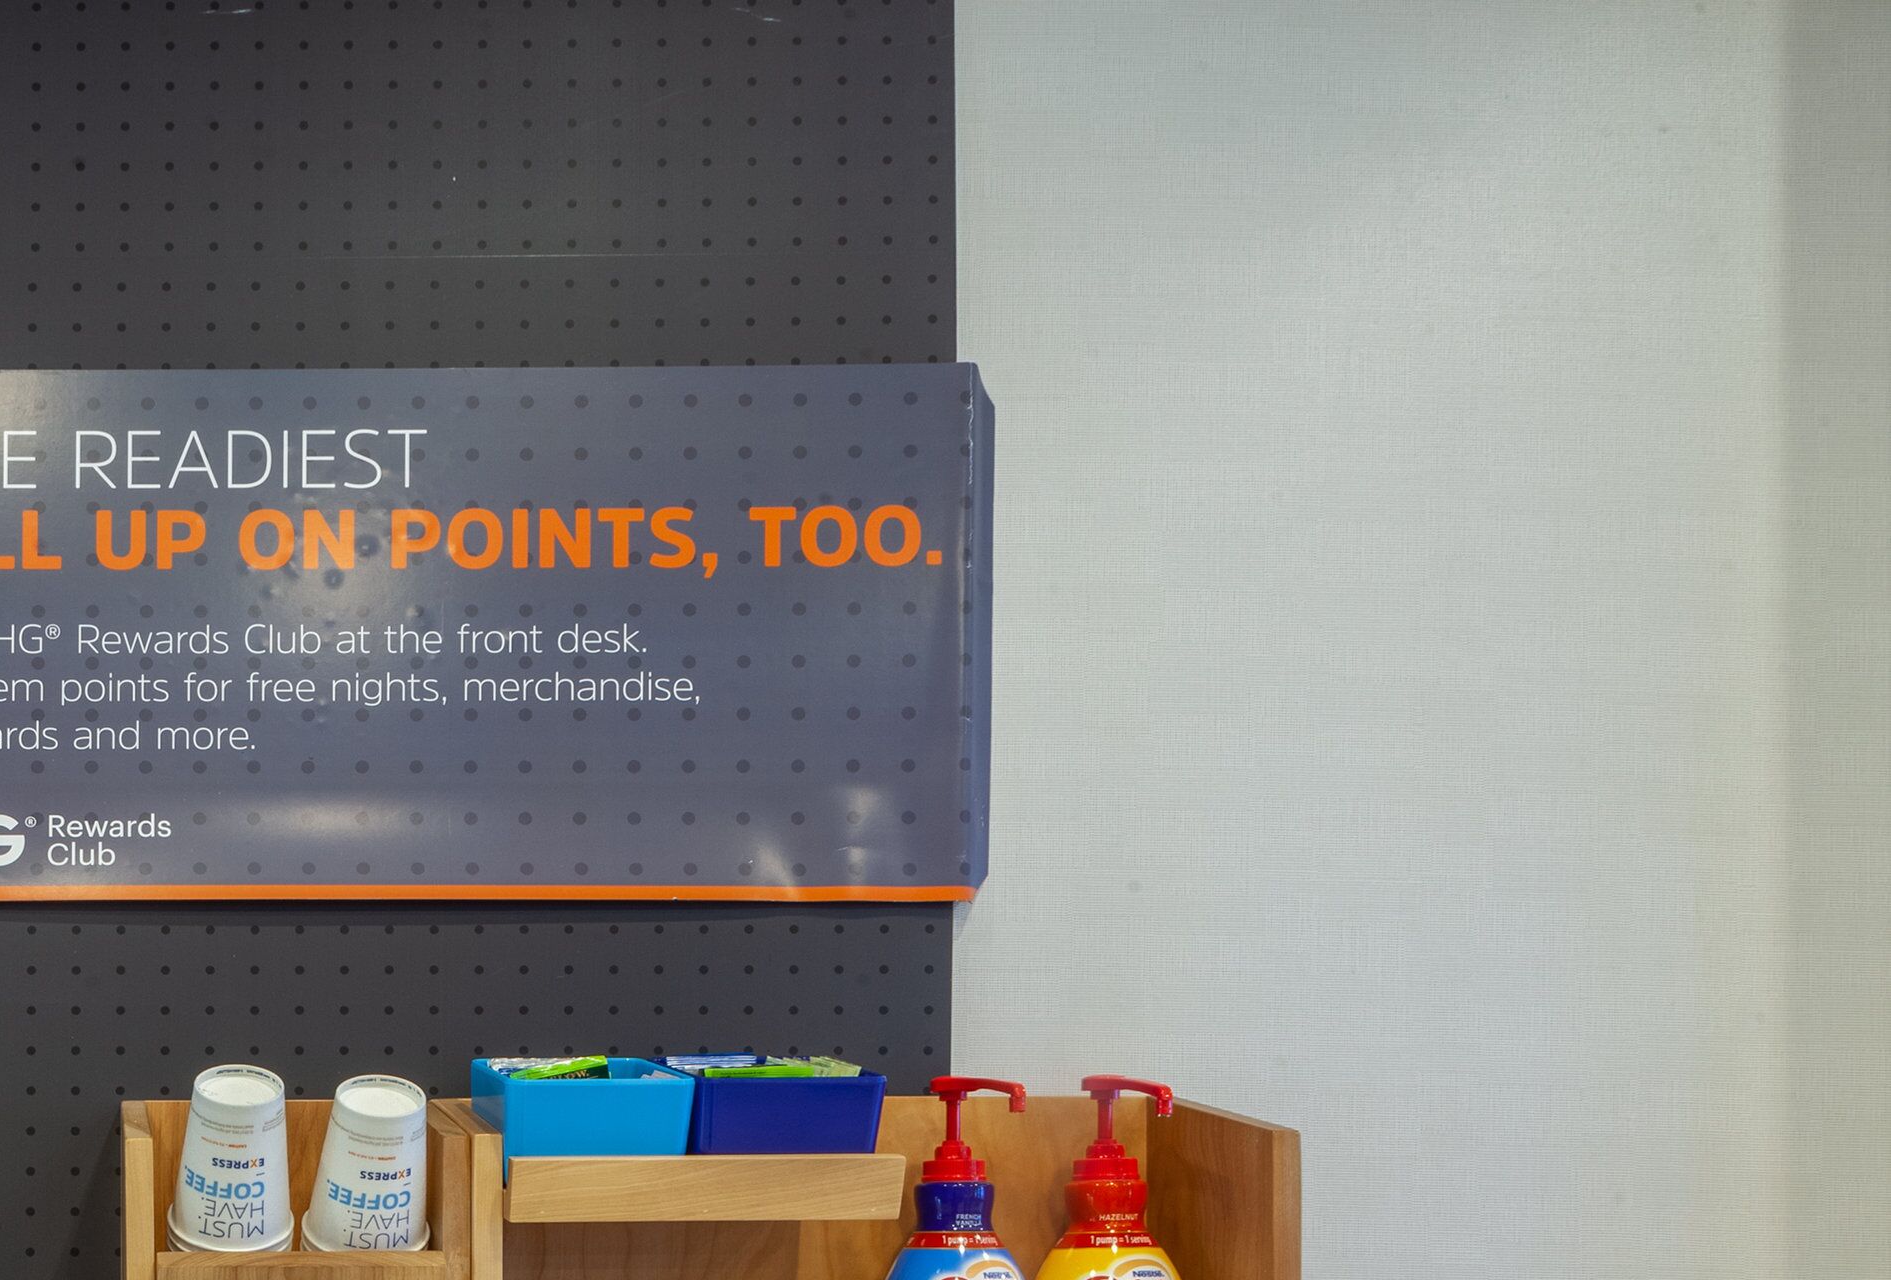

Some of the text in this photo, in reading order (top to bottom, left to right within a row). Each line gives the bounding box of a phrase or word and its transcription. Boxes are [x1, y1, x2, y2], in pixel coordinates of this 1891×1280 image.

[75, 427, 428, 490] READIEST
[95, 508, 208, 571] UP
[238, 508, 355, 571] ON
[390, 506, 719, 578] POINTS,
[749, 504, 943, 568] TOO.
[76, 623, 230, 655] Rewards
[243, 623, 322, 655] Club
[335, 626, 371, 655] at
[384, 622, 443, 655] the
[457, 622, 543, 655] front
[556, 622, 648, 655] desk.
[60, 671, 170, 707] points
[183, 670, 233, 703] for
[245, 670, 316, 703] free
[331, 670, 448, 708] nights,
[462, 670, 702, 706] merchandise,
[72, 719, 141, 751] and
[155, 725, 257, 751] more.
[47, 813, 173, 840] Rewards
[47, 841, 117, 868] Club
[212, 1157, 265, 1170] EXPRESS
[359, 1168, 412, 1181] EXPRESS
[184, 1164, 265, 1200] COFFEE.
[327, 1178, 411, 1211] COFFEE.
[200, 1196, 265, 1220] HAVE.
[347, 1210, 410, 1231] HAVE.
[1098, 1213, 1139, 1221] HAZELNUT
[198, 1216, 265, 1239] MUST.
[343, 1228, 409, 1250] MUST.
[1090, 1235, 1095, 1244] 1
[1095, 1236, 1118, 1246] pump
